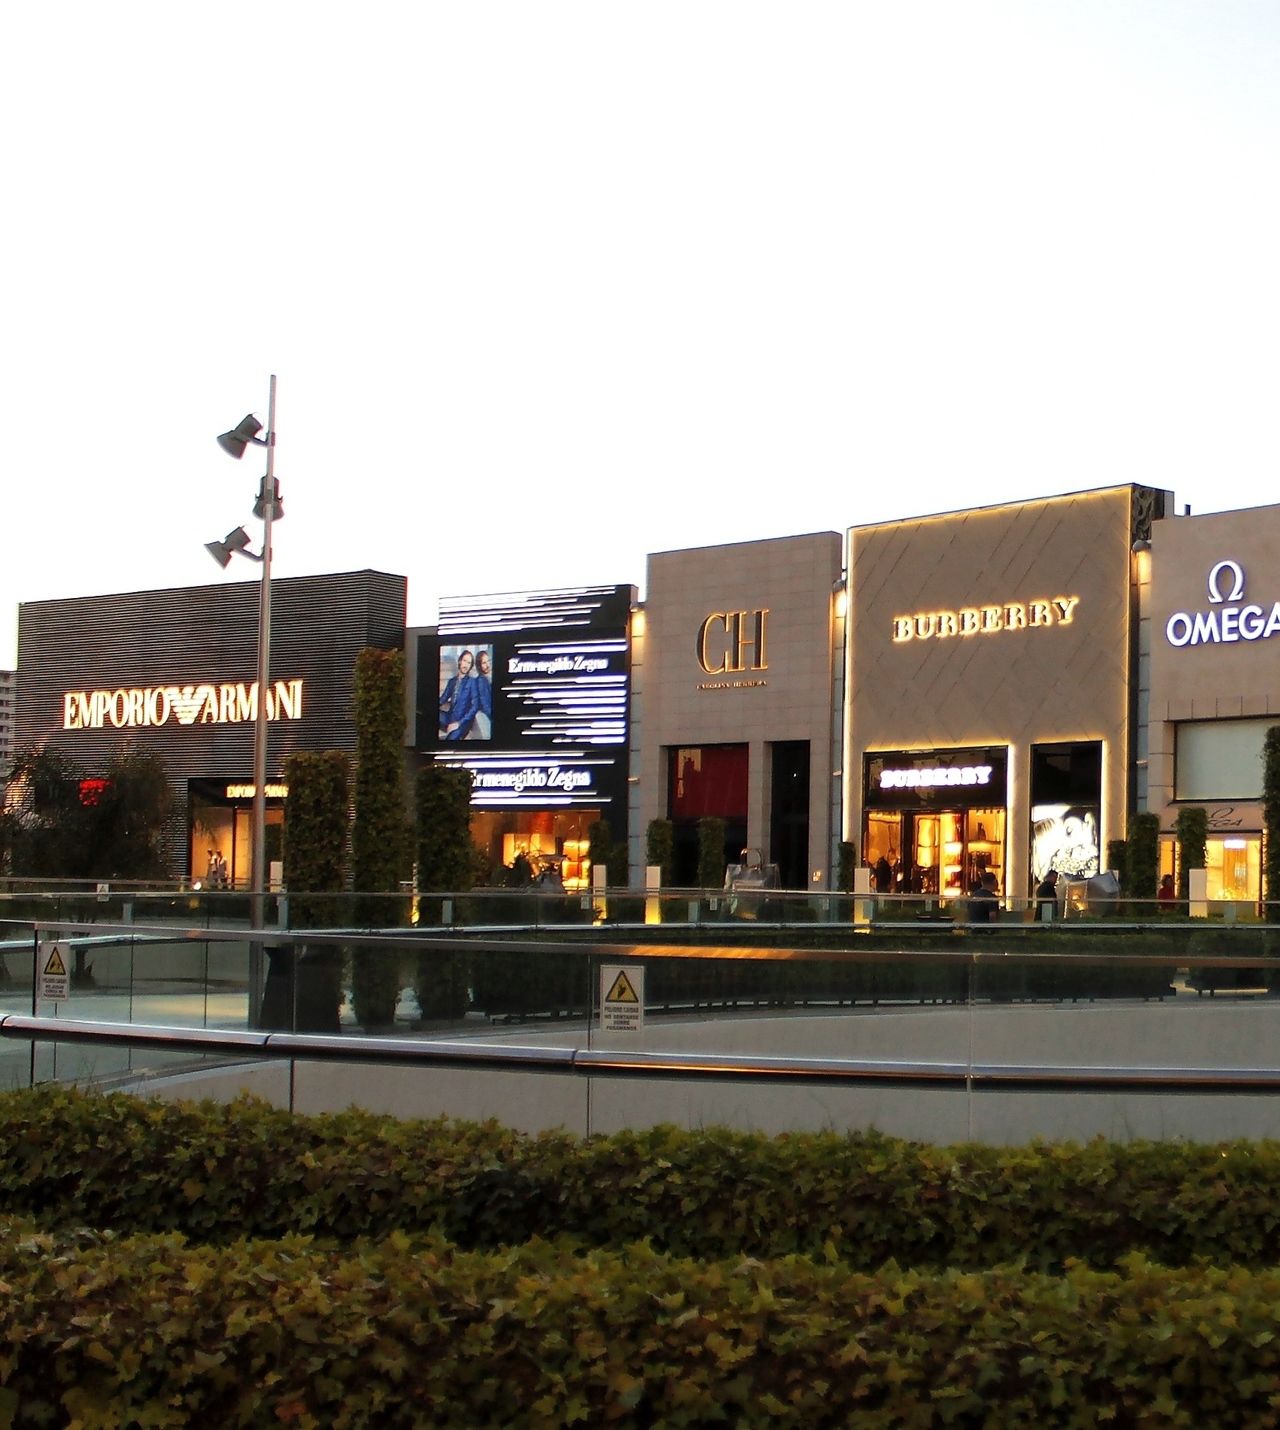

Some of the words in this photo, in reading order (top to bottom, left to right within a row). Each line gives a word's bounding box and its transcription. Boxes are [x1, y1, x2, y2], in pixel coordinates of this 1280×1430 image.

[892, 596, 1080, 642] BURBERRY
[695, 608, 770, 675] CH
[507, 655, 575, 675] Ermenegildo
[572, 655, 609, 673] Zegna
[63, 686, 172, 729] EMPORIO
[546, 766, 592, 791] Zegna
[879, 765, 993, 789] BURBERRY
